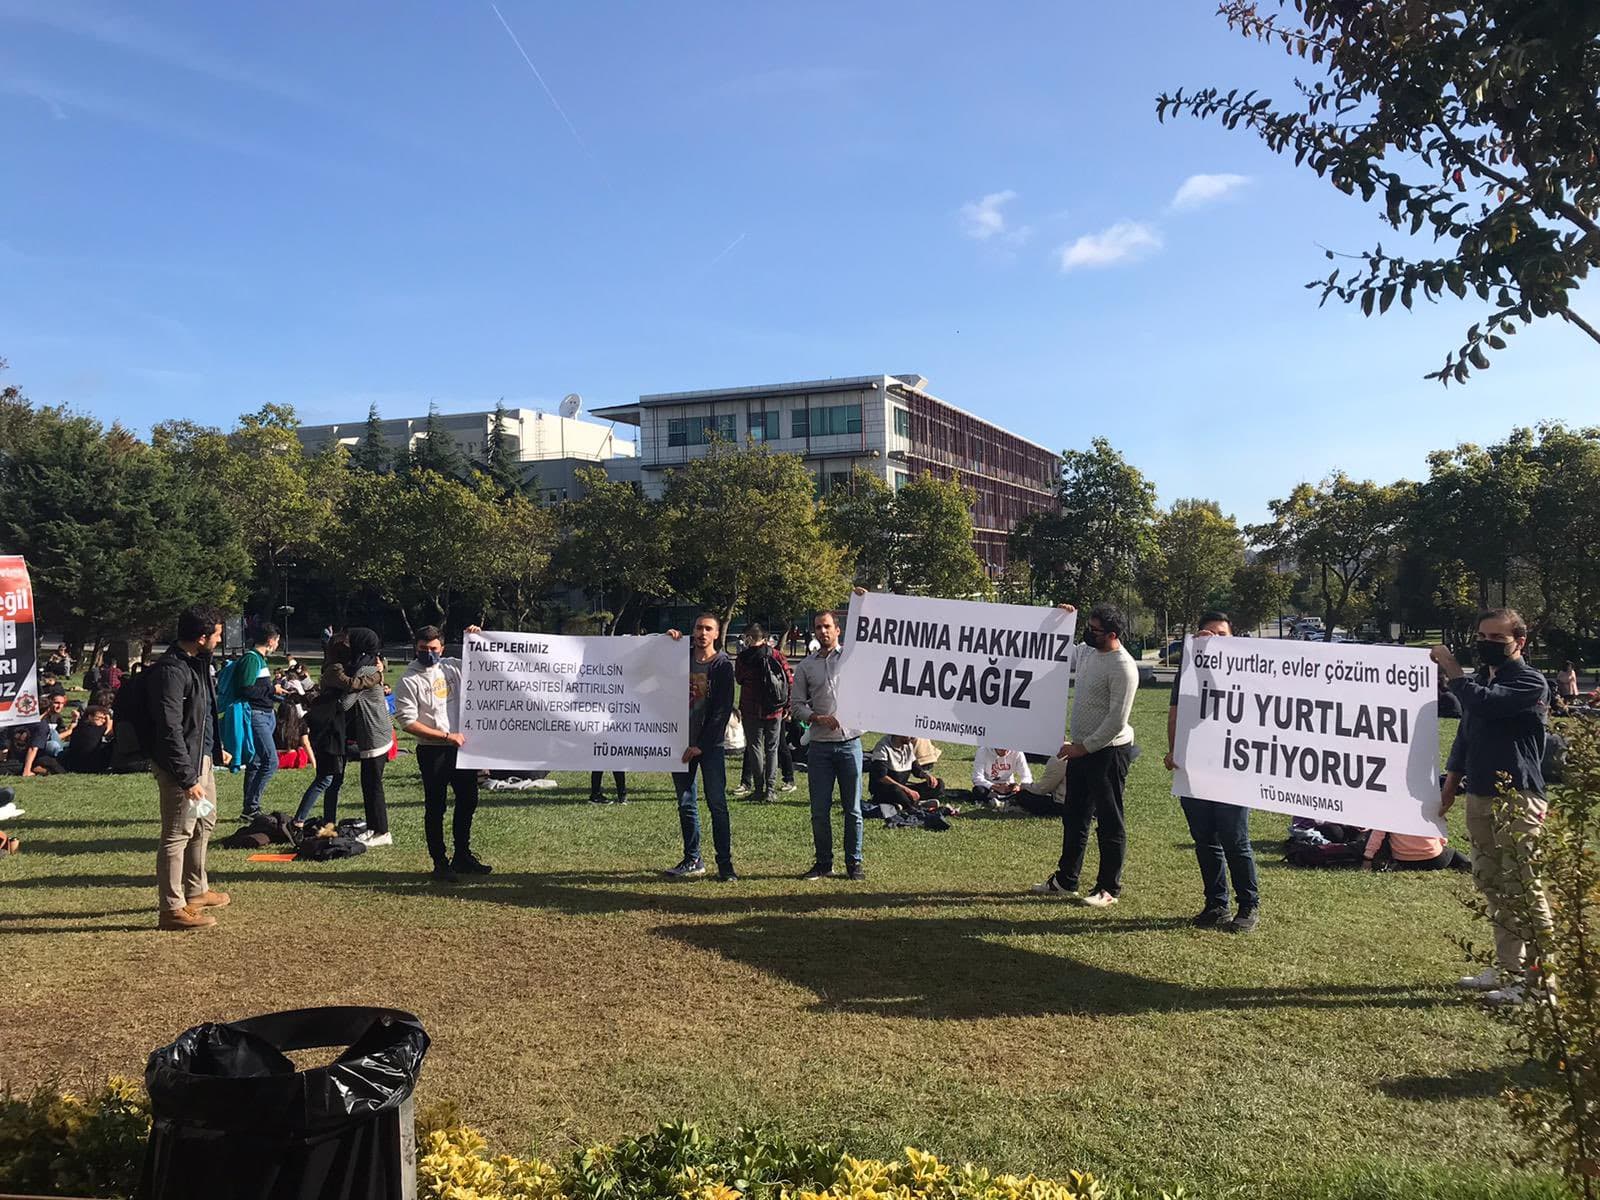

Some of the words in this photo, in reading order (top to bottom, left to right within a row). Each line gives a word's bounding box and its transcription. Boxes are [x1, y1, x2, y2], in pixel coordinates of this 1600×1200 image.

[468, 640, 549, 654] TALEPLERİMİZ
[856, 616, 951, 651] BARINMA
[958, 626, 1070, 662] HAKKIMIZ
[469, 661, 476, 672] 1.
[478, 660, 505, 672] YURT
[507, 661, 550, 673] ZAMLARI
[553, 661, 577, 674] GERİ
[579, 663, 623, 677] ÇEKİLSİN
[1194, 650, 1222, 670] özel
[1226, 653, 1277, 678] yurtlar,
[1282, 657, 1321, 678] evler
[1325, 660, 1379, 685] çözüm
[1385, 664, 1430, 693] değil
[466, 680, 475, 691] 2.
[478, 680, 504, 691] YURT
[506, 680, 563, 693] KAPASİTESİ
[565, 683, 625, 695] ARTTIRILSIN
[879, 657, 1034, 709] ALACAĞIZ
[465, 700, 474, 711] 3.
[476, 699, 524, 711] VAKIFLAR
[608, 701, 641, 714] GİTSİN
[1200, 680, 1244, 724] İTÜ
[1254, 693, 1409, 744] YURTLARI
[465, 720, 473, 730] 4.
[476, 718, 497, 730] TÜM
[499, 718, 571, 731] ÖĞRENCİLERE
[574, 721, 600, 732] YURT
[602, 721, 631, 733] HAKKI
[634, 722, 678, 733] TANINSIN
[915, 714, 929, 729] İTÜ
[929, 719, 986, 737] DAYANIŞMASI
[593, 742, 608, 756] İTÜ
[610, 746, 671, 759] DAYANIŞMASI
[1223, 729, 1387, 792] İSTİYORUZ
[1260, 783, 1276, 801] İTÜ
[1278, 787, 1343, 812] DAYANIŞMASI
